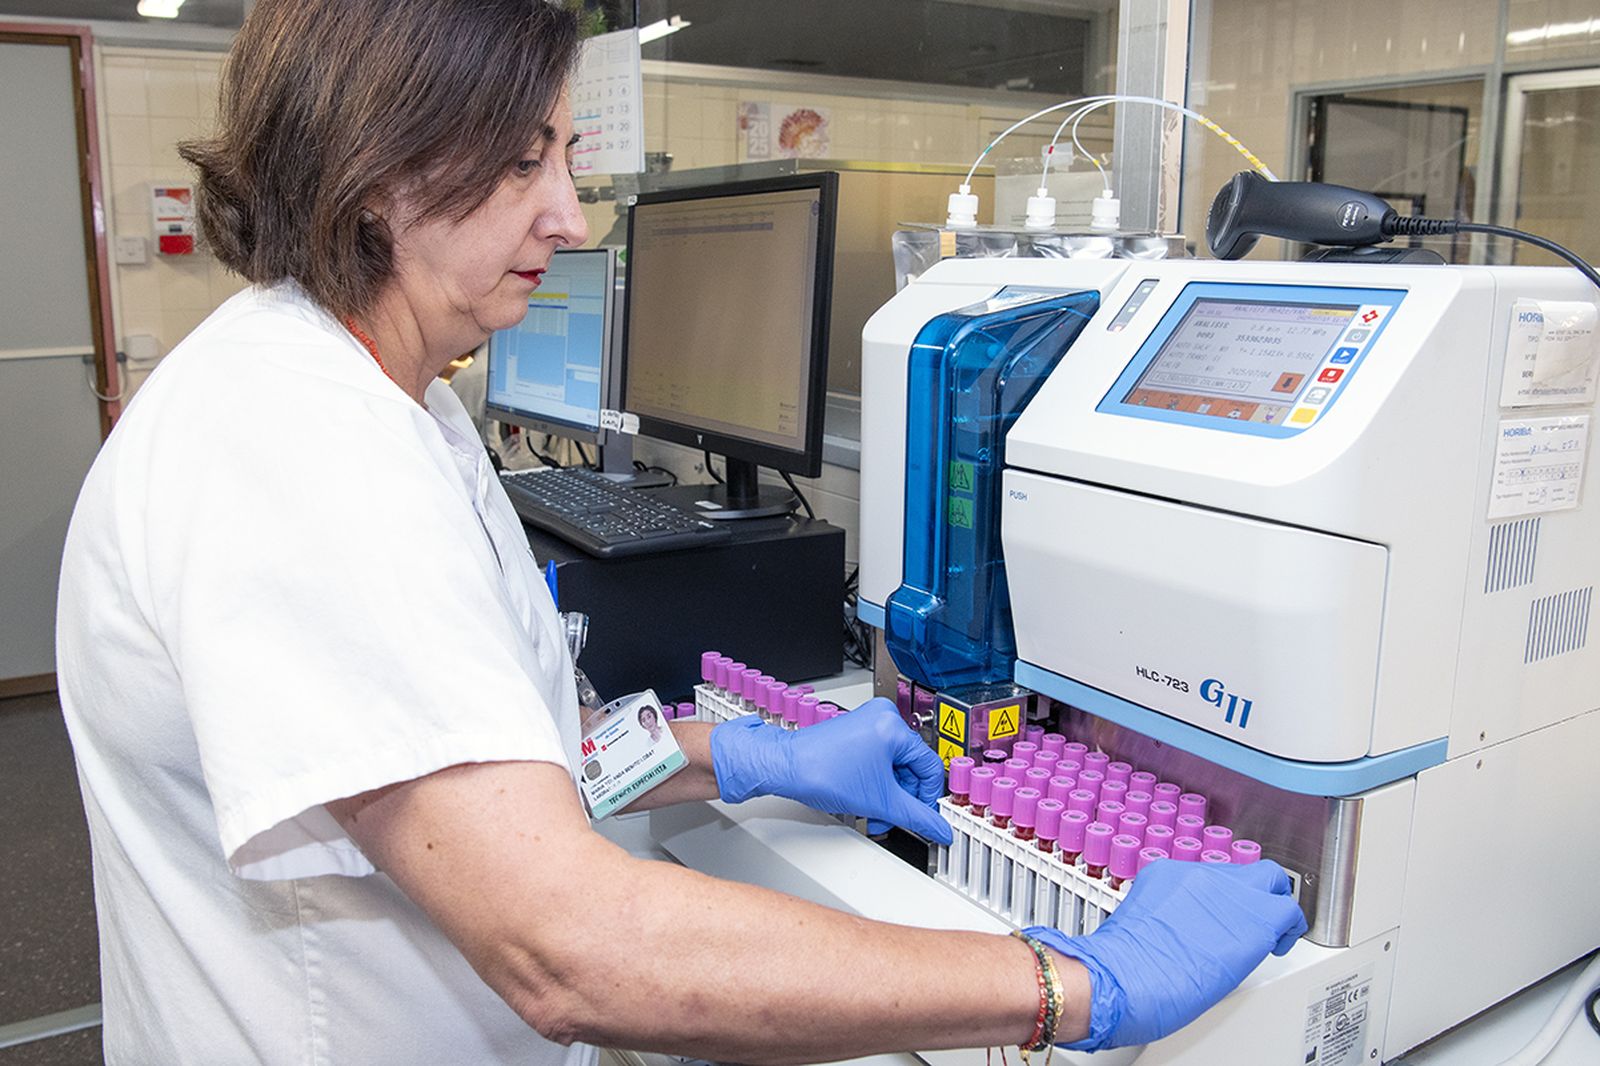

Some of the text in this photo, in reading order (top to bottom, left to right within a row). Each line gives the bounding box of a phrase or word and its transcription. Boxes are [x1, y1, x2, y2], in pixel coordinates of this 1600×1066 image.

[749, 121, 769, 137] 20
[749, 138, 769, 155] 25
[1503, 426, 1532, 437] HORIBA
[1009, 489, 1028, 501] PUSH
[1135, 665, 1190, 693] HLC-723
[631, 763, 668, 790] ESPECIALISTA
